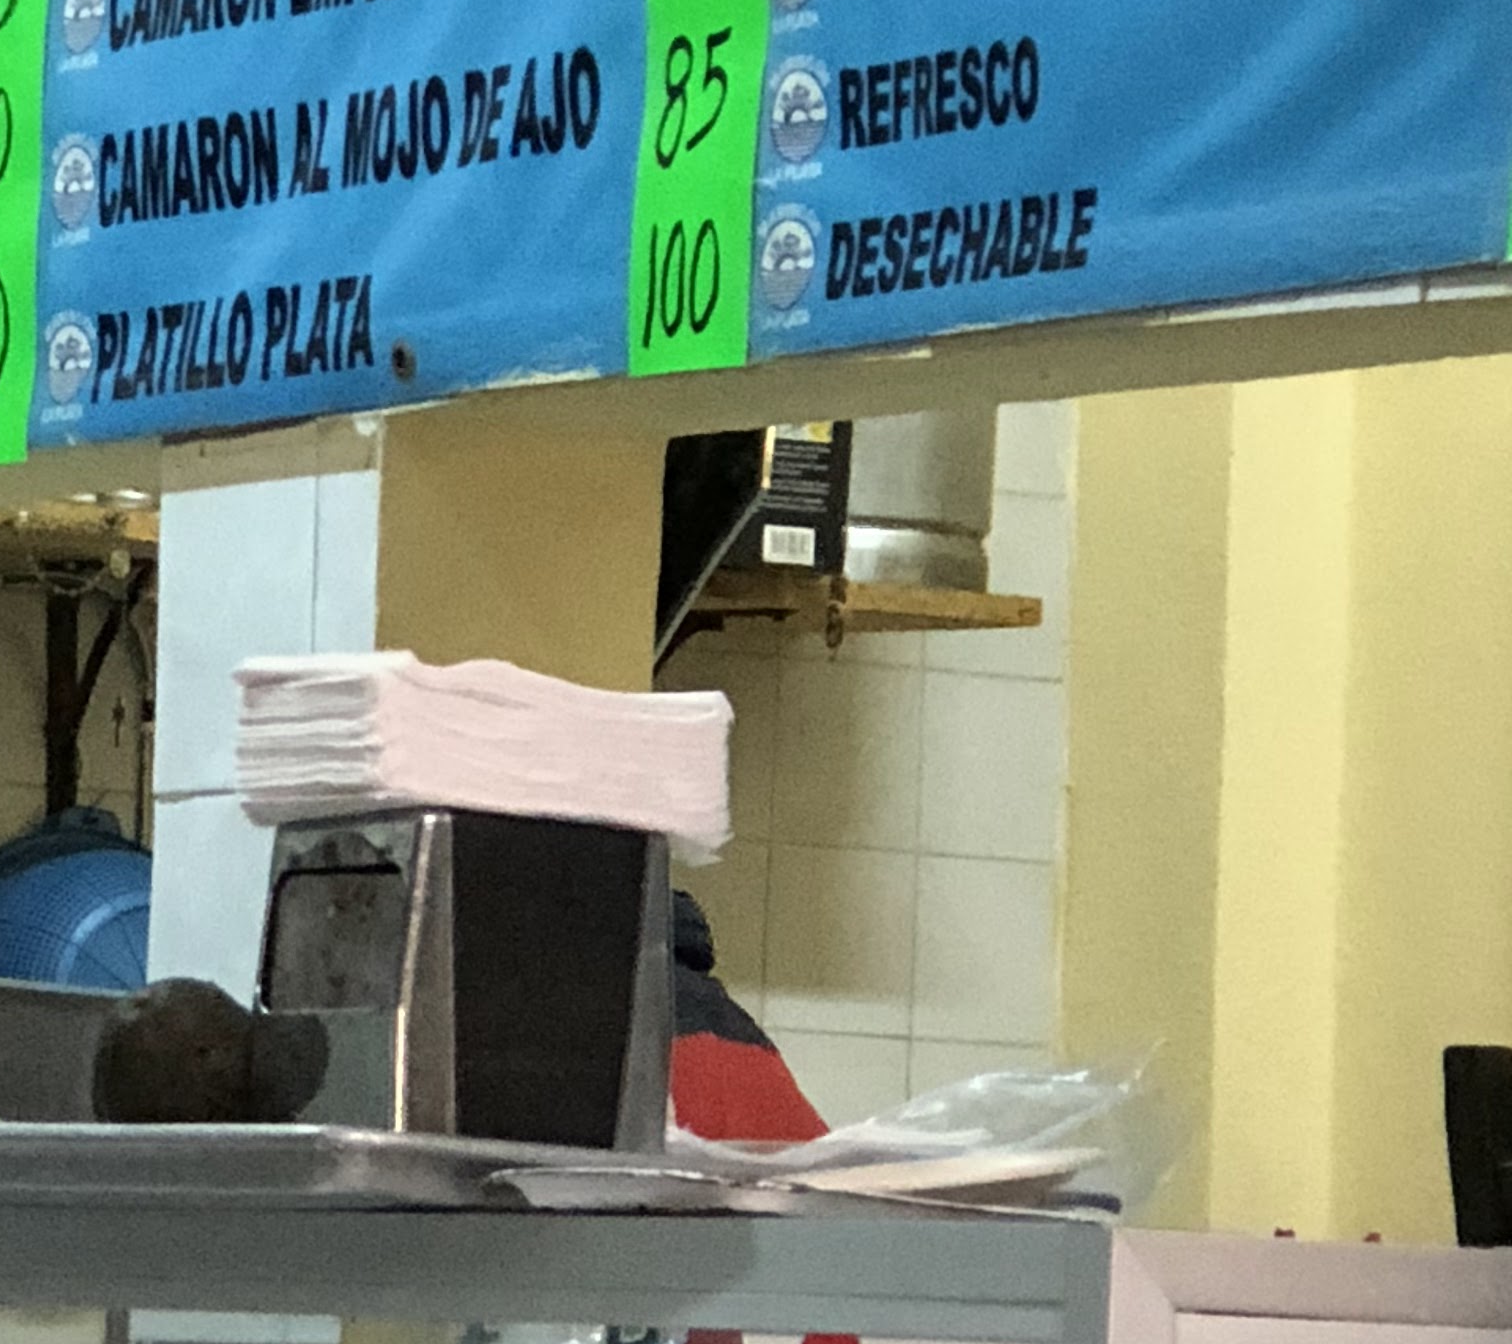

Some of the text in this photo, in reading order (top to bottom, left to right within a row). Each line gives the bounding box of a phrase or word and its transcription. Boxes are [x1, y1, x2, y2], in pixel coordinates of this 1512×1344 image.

[98, 46, 601, 230] CAMARON AL MOJO DE AJO
[654, 27, 733, 170] 85
[839, 36, 1040, 150] REFRESCO
[642, 218, 721, 350] 100
[825, 187, 1098, 301] DESECHABLE
[91, 274, 375, 403] PLATILLO PLATA
